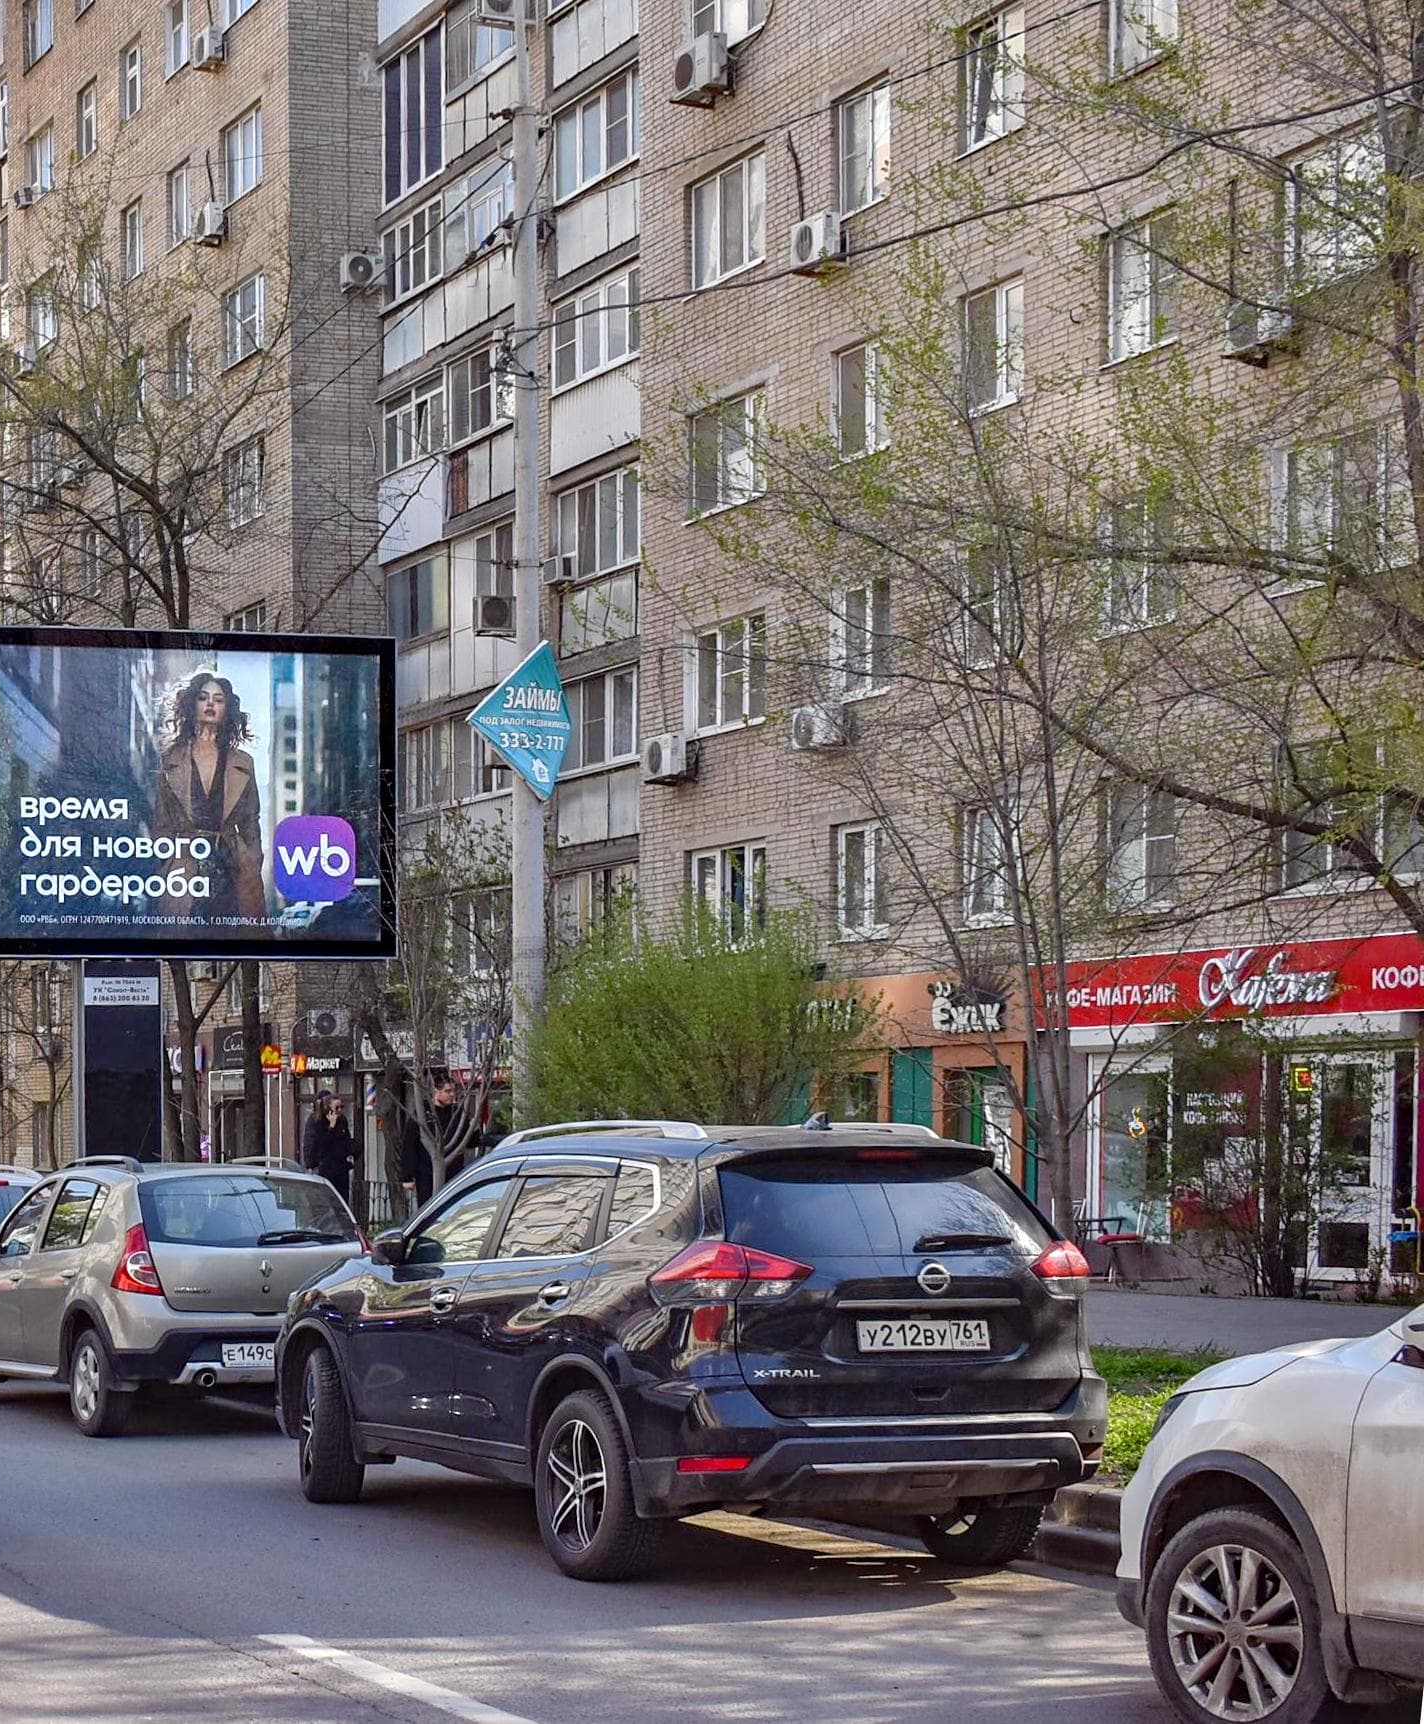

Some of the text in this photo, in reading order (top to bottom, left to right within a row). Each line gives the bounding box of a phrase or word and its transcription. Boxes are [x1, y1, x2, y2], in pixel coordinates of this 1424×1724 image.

[503, 682, 562, 711] ЗАЙМЫ
[479, 716, 498, 726] ПОД
[500, 717, 525, 727] ЗАЛОГ
[20, 796, 128, 825] время
[20, 827, 211, 860] для нового
[278, 834, 351, 877] wb
[20, 868, 210, 903] гардероба
[20, 915, 36, 923] ООО
[61, 915, 77, 924] ОГРН
[132, 916, 176, 925] МОСКОВСКАЯ
[1046, 983, 1177, 1009] КФЕ-МАГАЗИН
[866, 1322, 983, 1347] У212ВУ 761
[227, 1345, 273, 1361] Е149С
[753, 1369, 821, 1378] X-TRAIL
